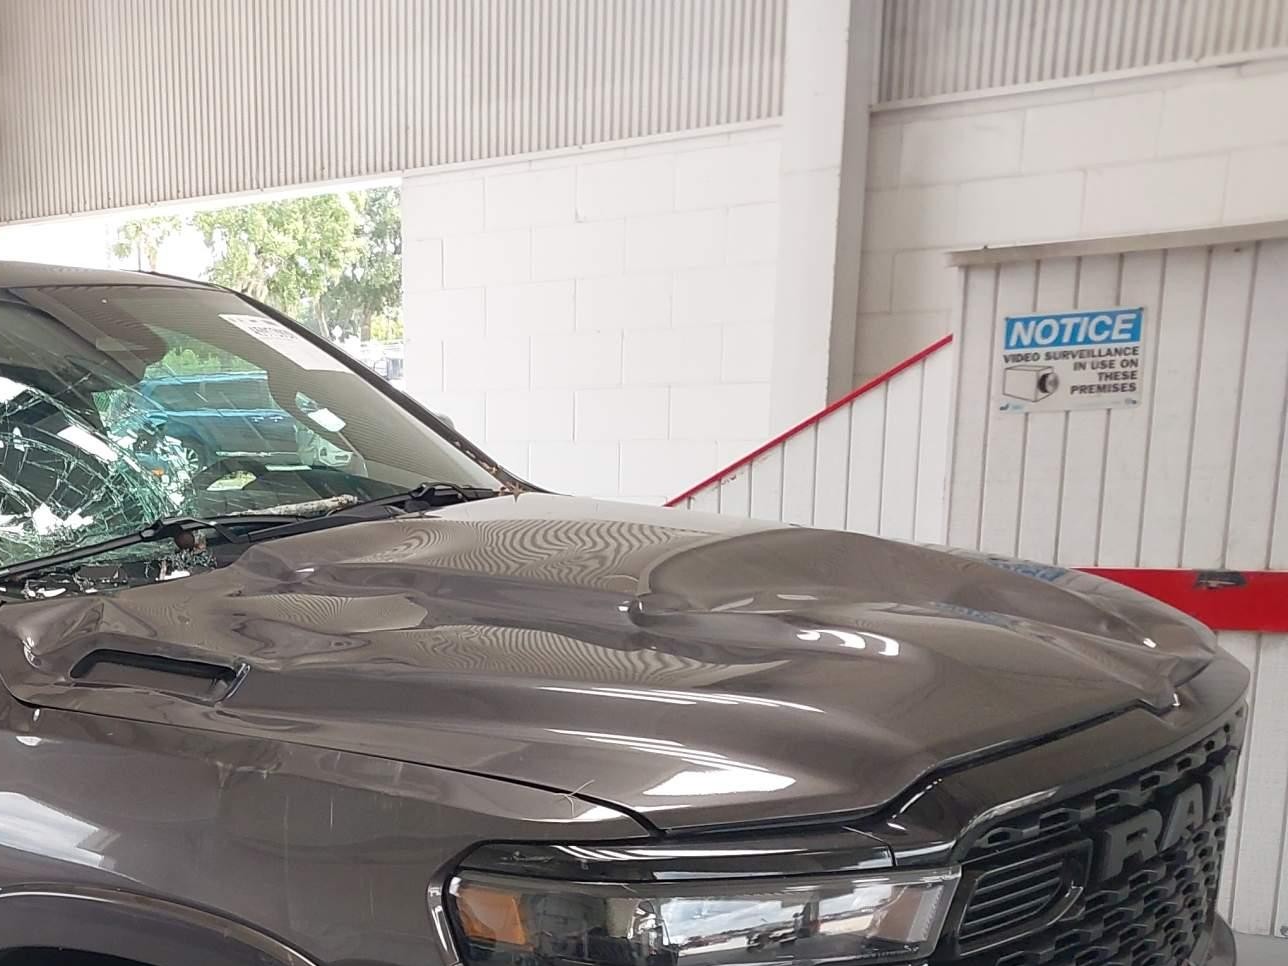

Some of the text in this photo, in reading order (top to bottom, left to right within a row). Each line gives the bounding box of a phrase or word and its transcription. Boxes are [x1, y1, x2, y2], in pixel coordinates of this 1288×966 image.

[1009, 313, 1137, 347] NOTICE
[1003, 346, 1140, 363] VIDEO SURVEILLANCE
[1073, 358, 1139, 371] IN USE ON
[1098, 371, 1137, 381] THESE
[1070, 382, 1137, 395] PREMISES
